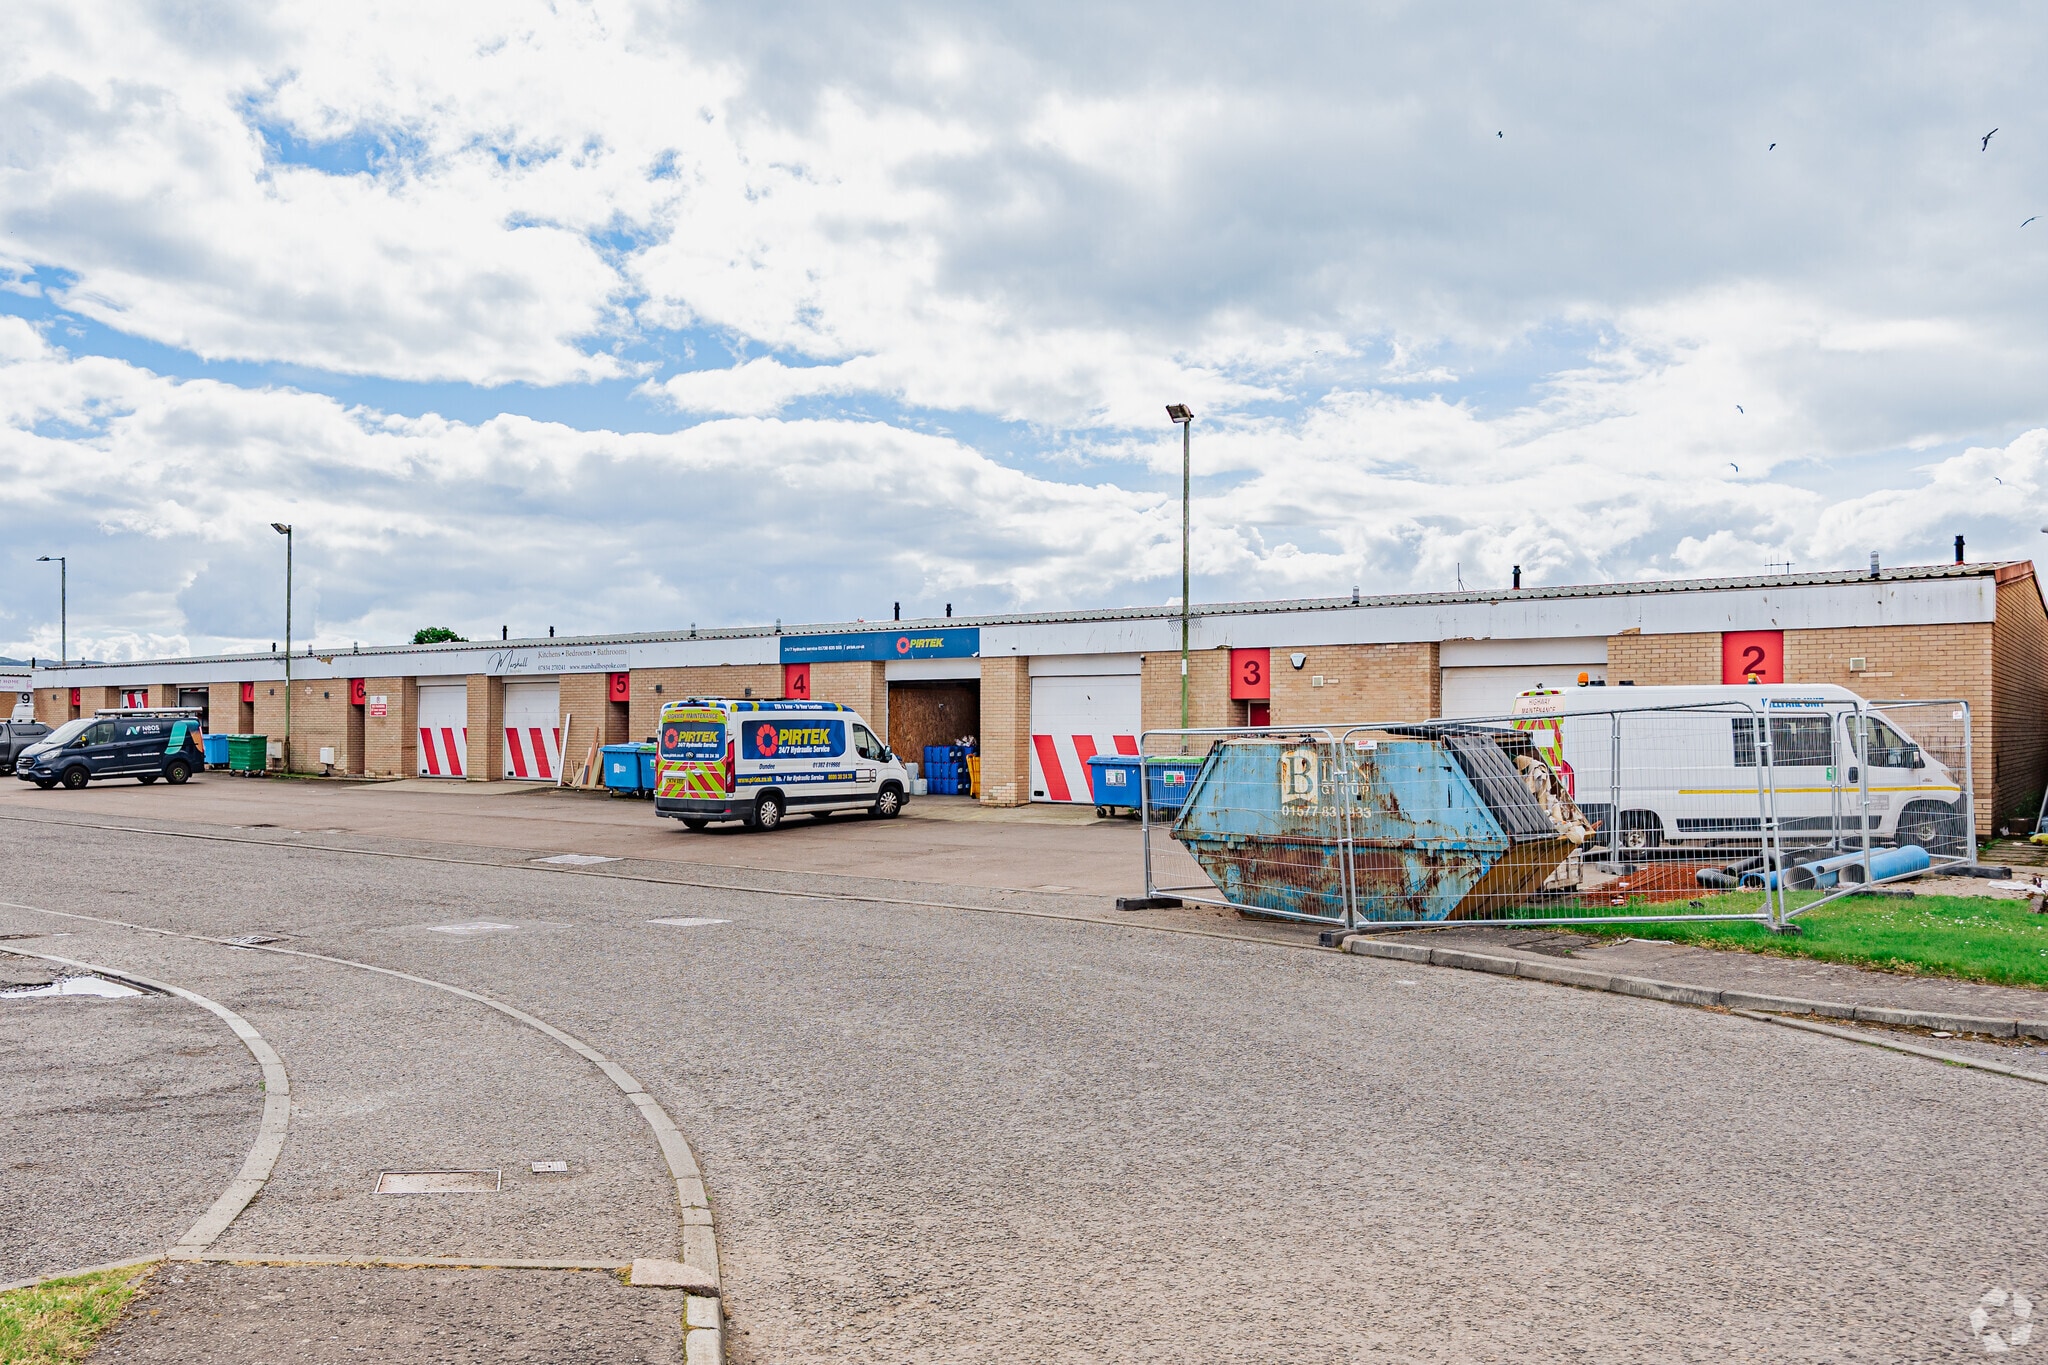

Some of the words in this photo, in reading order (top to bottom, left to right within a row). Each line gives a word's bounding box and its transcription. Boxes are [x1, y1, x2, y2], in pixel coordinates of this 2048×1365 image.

[910, 638, 944, 648] PIRTEK
[565, 649, 592, 657] Bedrooms
[488, 650, 528, 674] Marshall
[1742, 646, 1766, 675] 2
[1243, 661, 1261, 685] 3
[356, 682, 364, 698] 6
[616, 675, 626, 693] 5
[793, 674, 806, 693] 4
[75, 688, 80, 702] 8
[247, 684, 253, 698] 7
[21, 693, 30, 704] 9
[678, 731, 719, 742] PIRTEK
[779, 729, 831, 745] PIRTEK
[778, 746, 789, 754] 24/7
[790, 746, 812, 754] Hydraulic
[1281, 805, 1318, 817] 01577
